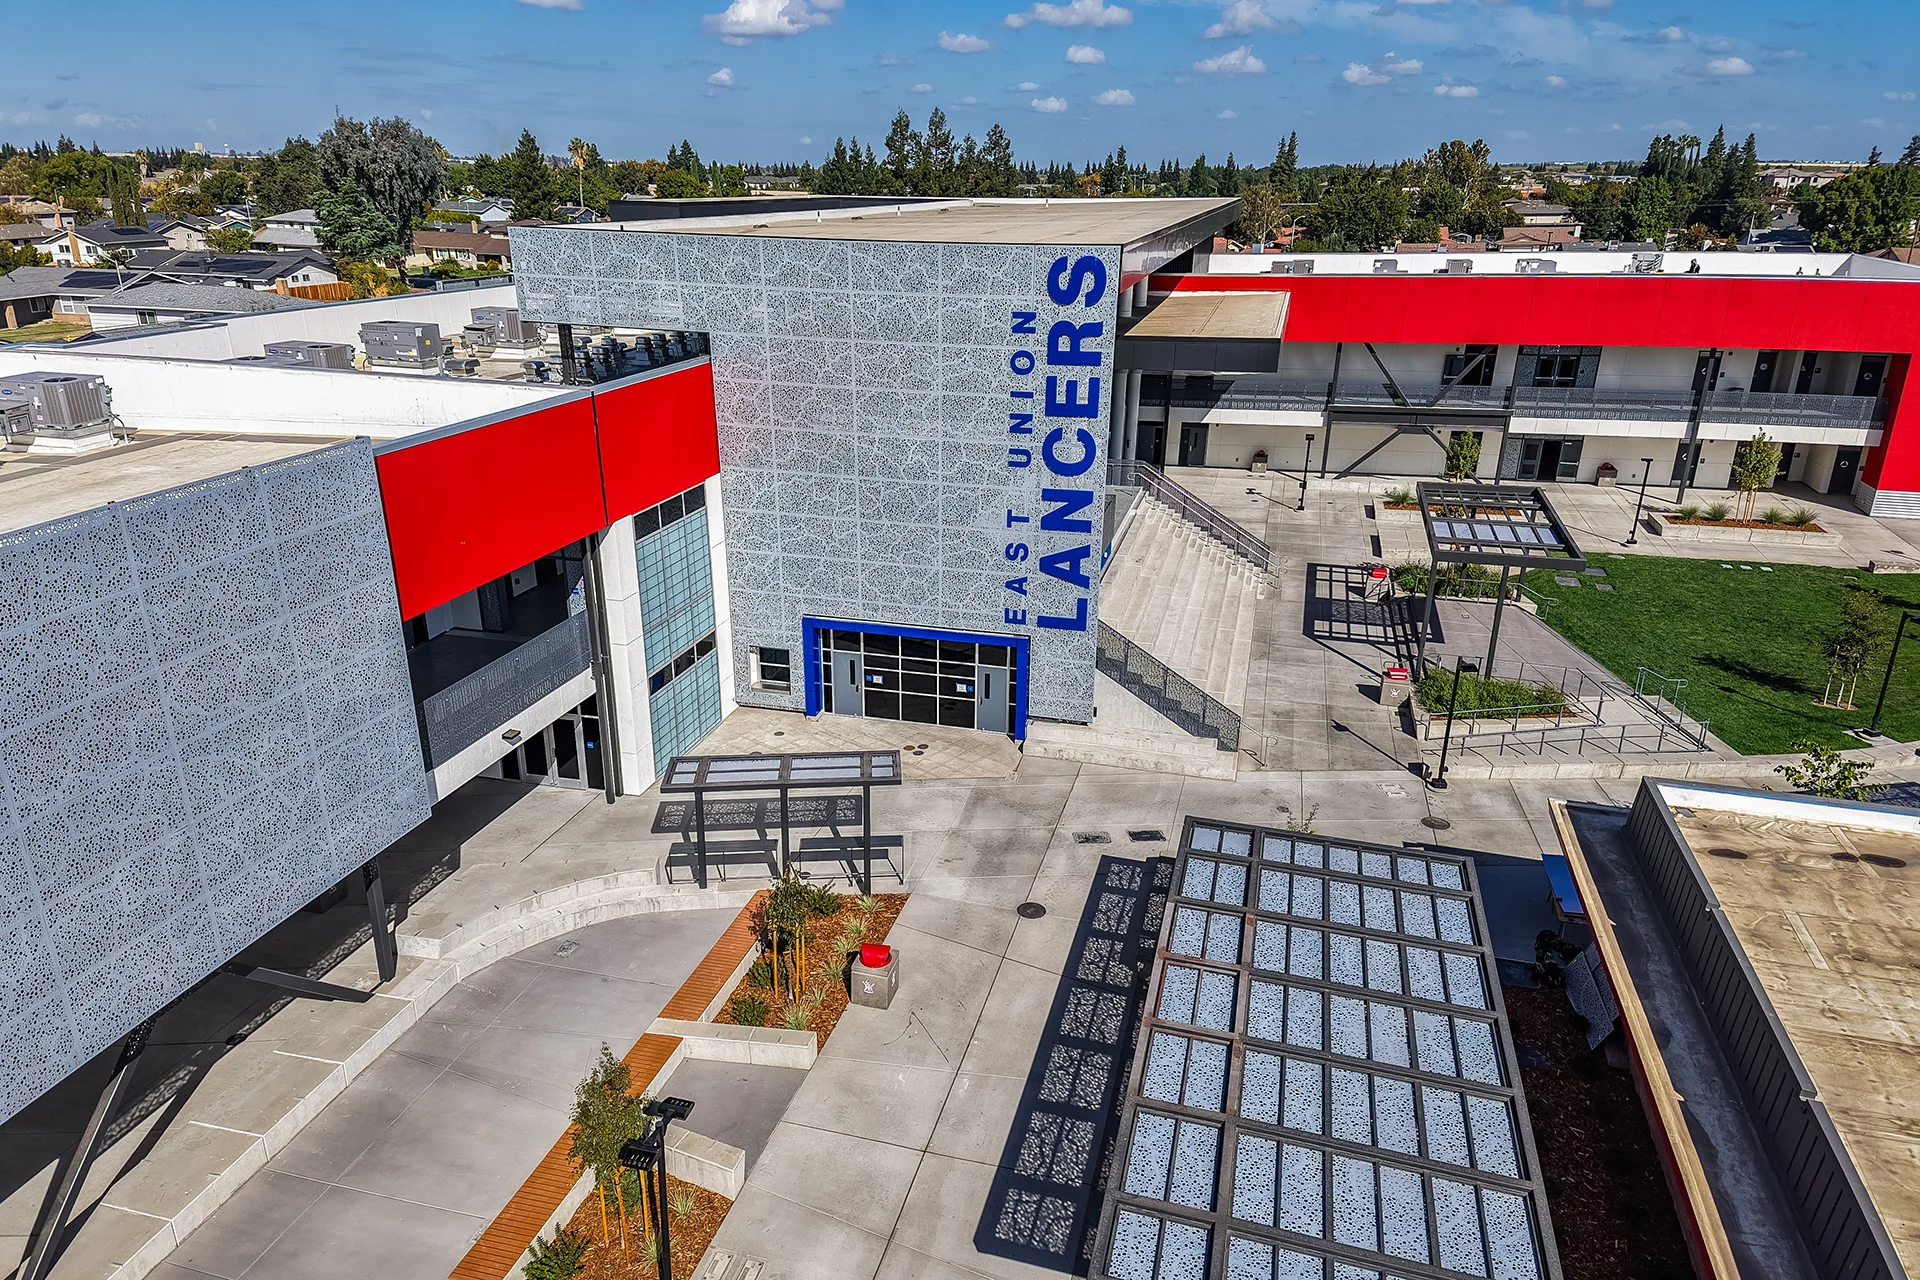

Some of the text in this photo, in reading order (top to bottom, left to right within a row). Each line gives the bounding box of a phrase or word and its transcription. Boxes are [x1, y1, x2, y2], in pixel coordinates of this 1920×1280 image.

[1004, 310, 1038, 626] EAST UNION
[1036, 253, 1108, 633] LANCERS
